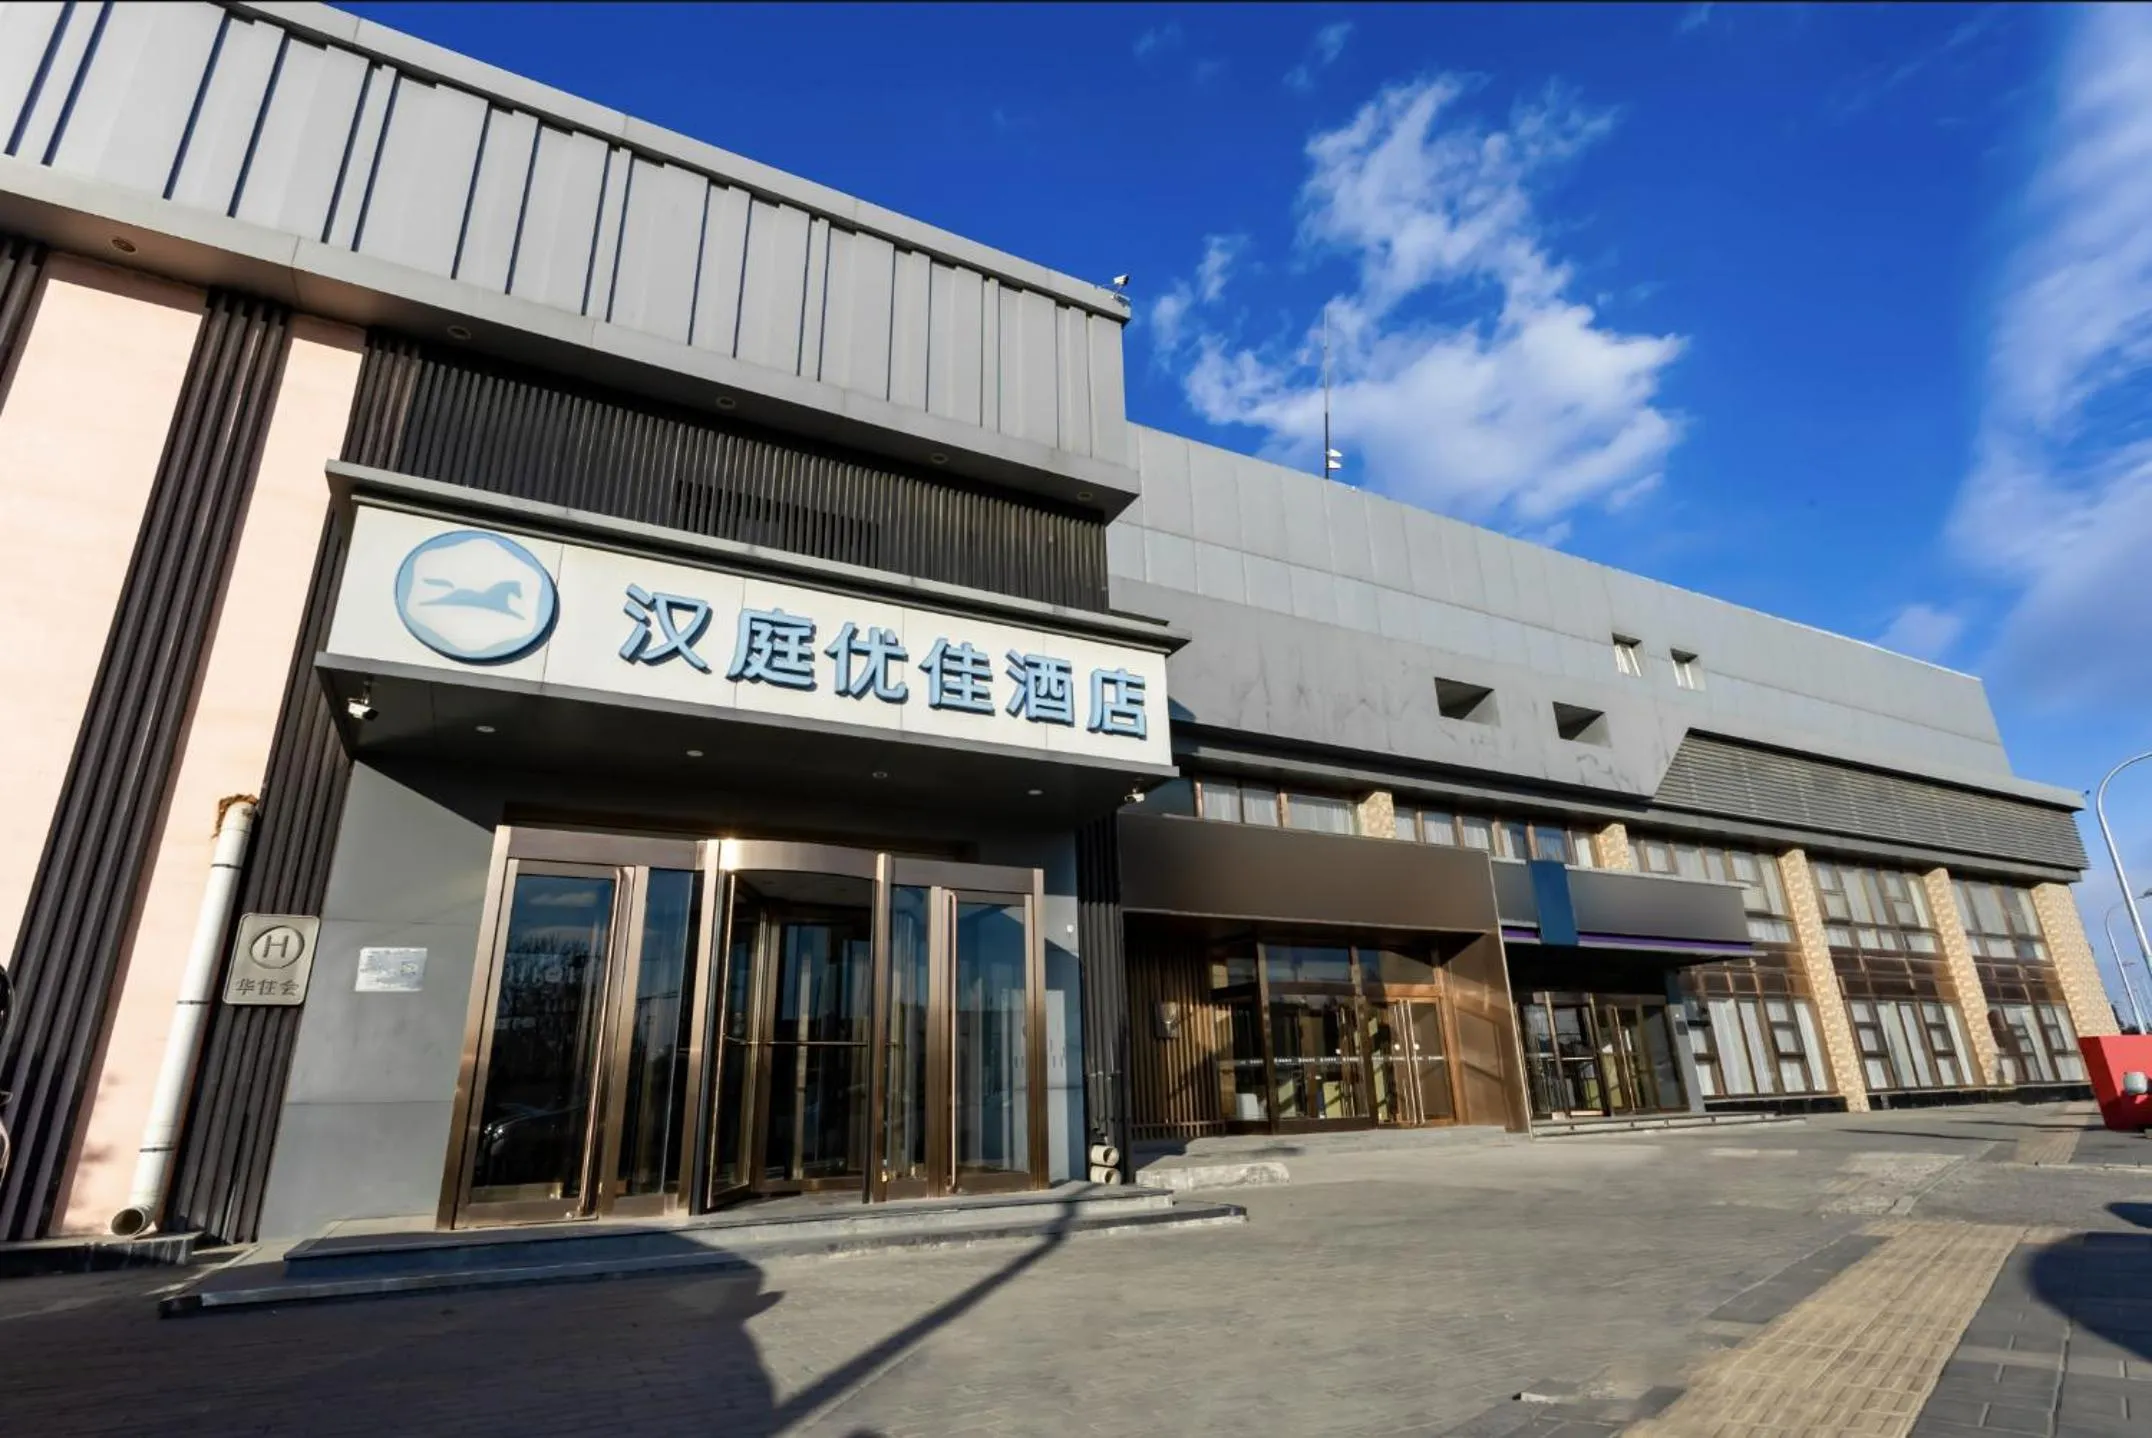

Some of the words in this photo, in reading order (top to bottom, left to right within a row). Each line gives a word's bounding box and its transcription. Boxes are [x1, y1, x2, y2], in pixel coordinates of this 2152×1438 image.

[620, 584, 1148, 739] 汉庭优佳酒店
[262, 935, 289, 958] H
[236, 977, 300, 997] 华住会
